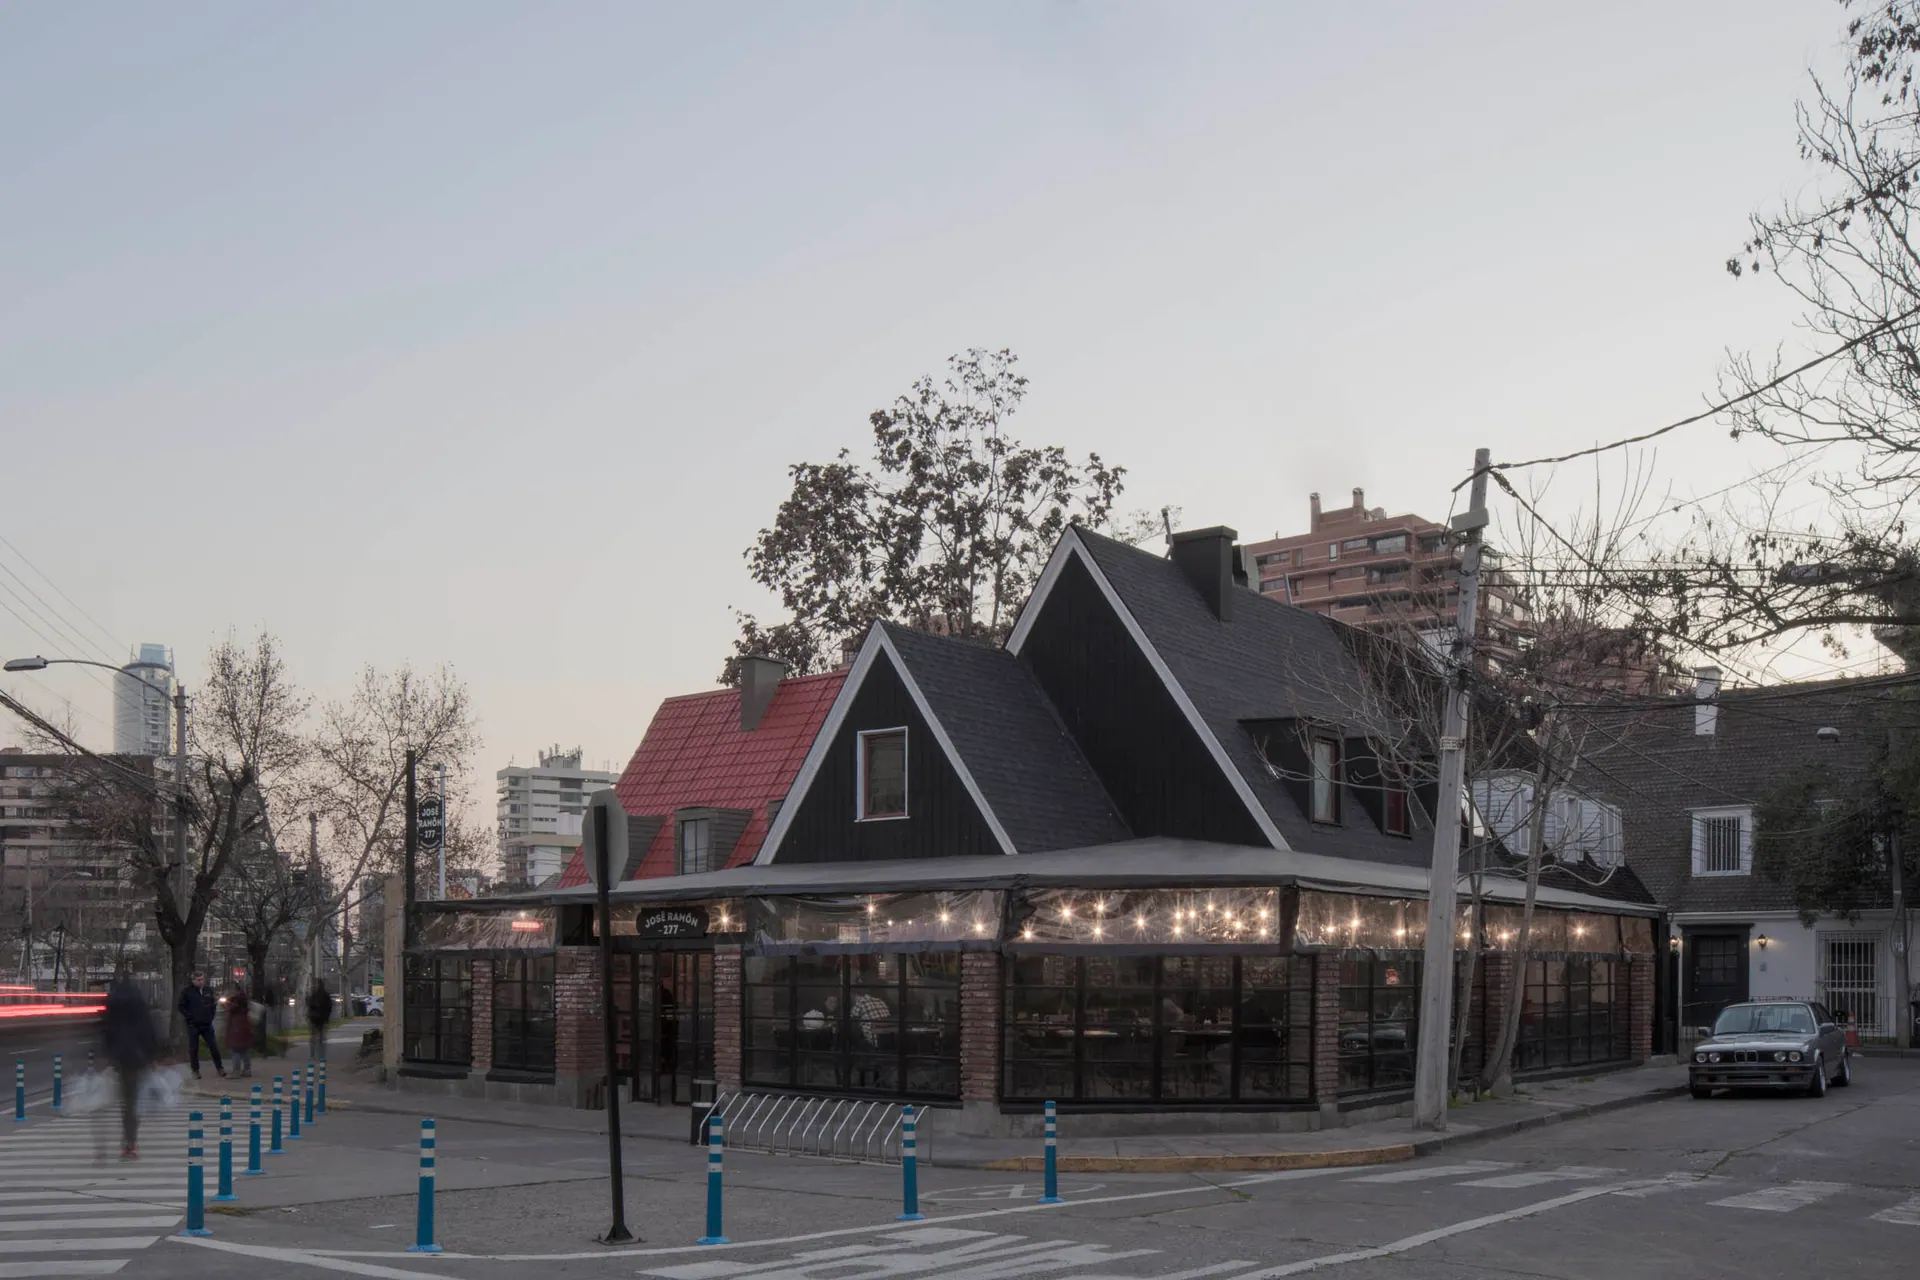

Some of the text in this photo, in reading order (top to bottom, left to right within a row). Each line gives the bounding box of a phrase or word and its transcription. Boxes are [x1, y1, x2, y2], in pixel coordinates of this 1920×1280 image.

[422, 806, 439, 817] JOSÉ
[419, 817, 442, 828] RAMÓN
[645, 911, 698, 928] JOSÉ RAMÓN
[663, 924, 678, 935] 277
